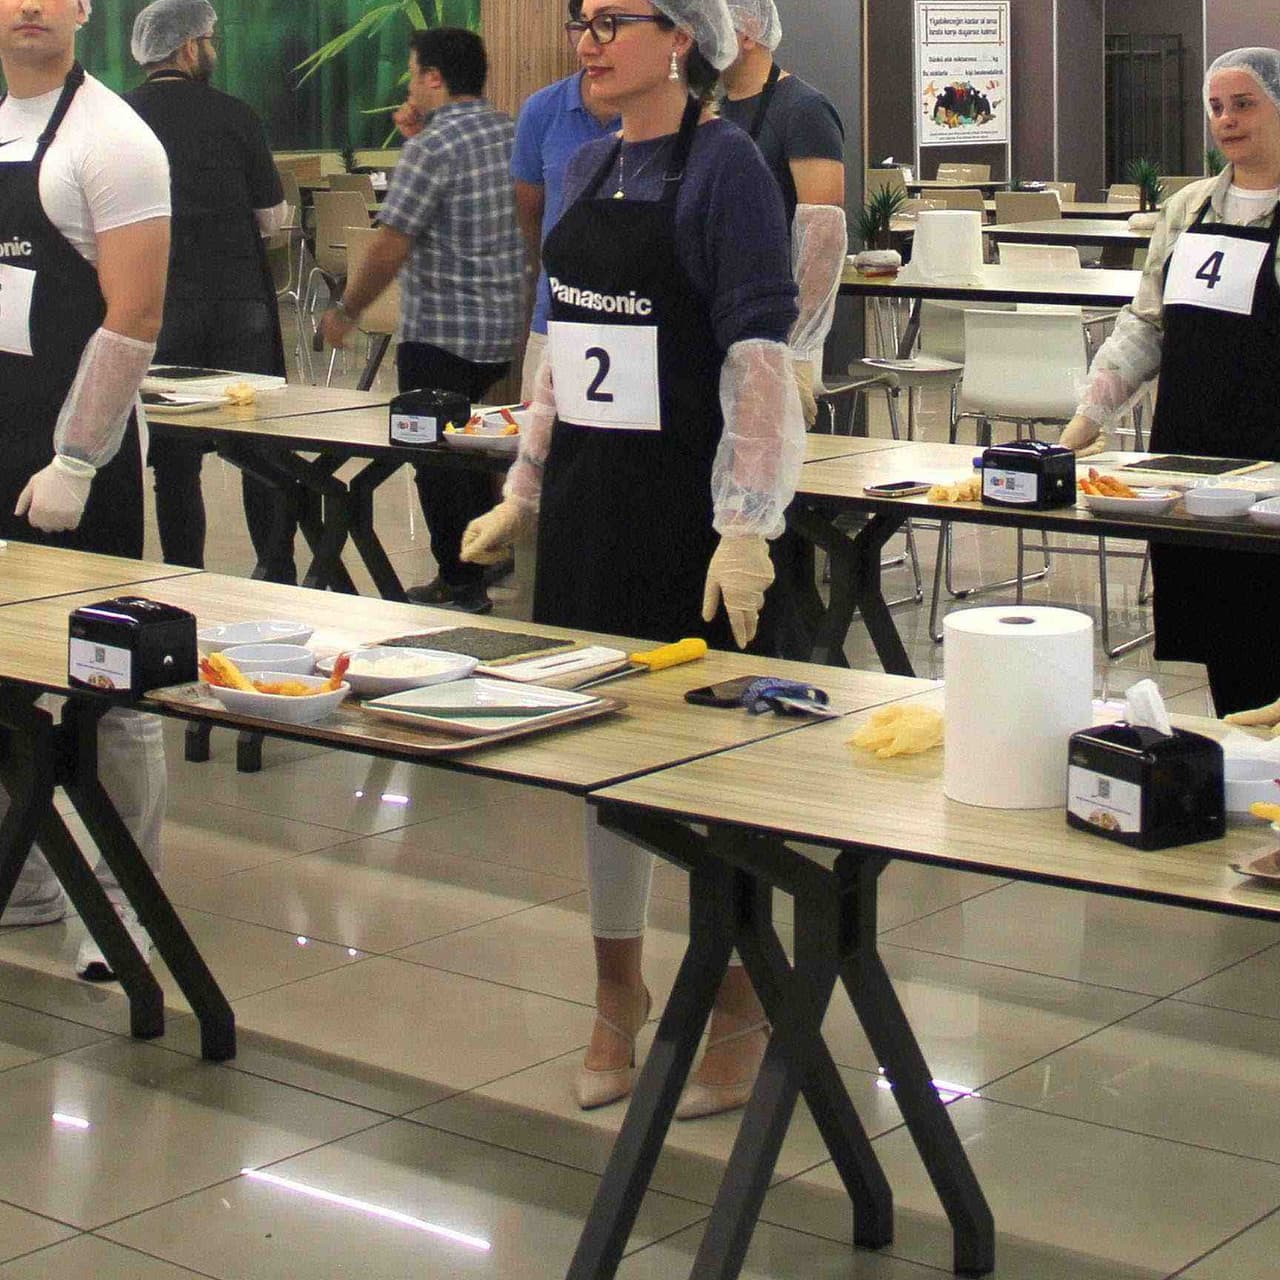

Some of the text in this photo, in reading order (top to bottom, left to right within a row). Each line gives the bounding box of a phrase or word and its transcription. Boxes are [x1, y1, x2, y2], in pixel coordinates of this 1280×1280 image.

[1195, 250, 1225, 289] 4
[549, 276, 652, 315] Panasonic
[585, 346, 613, 402] 2
